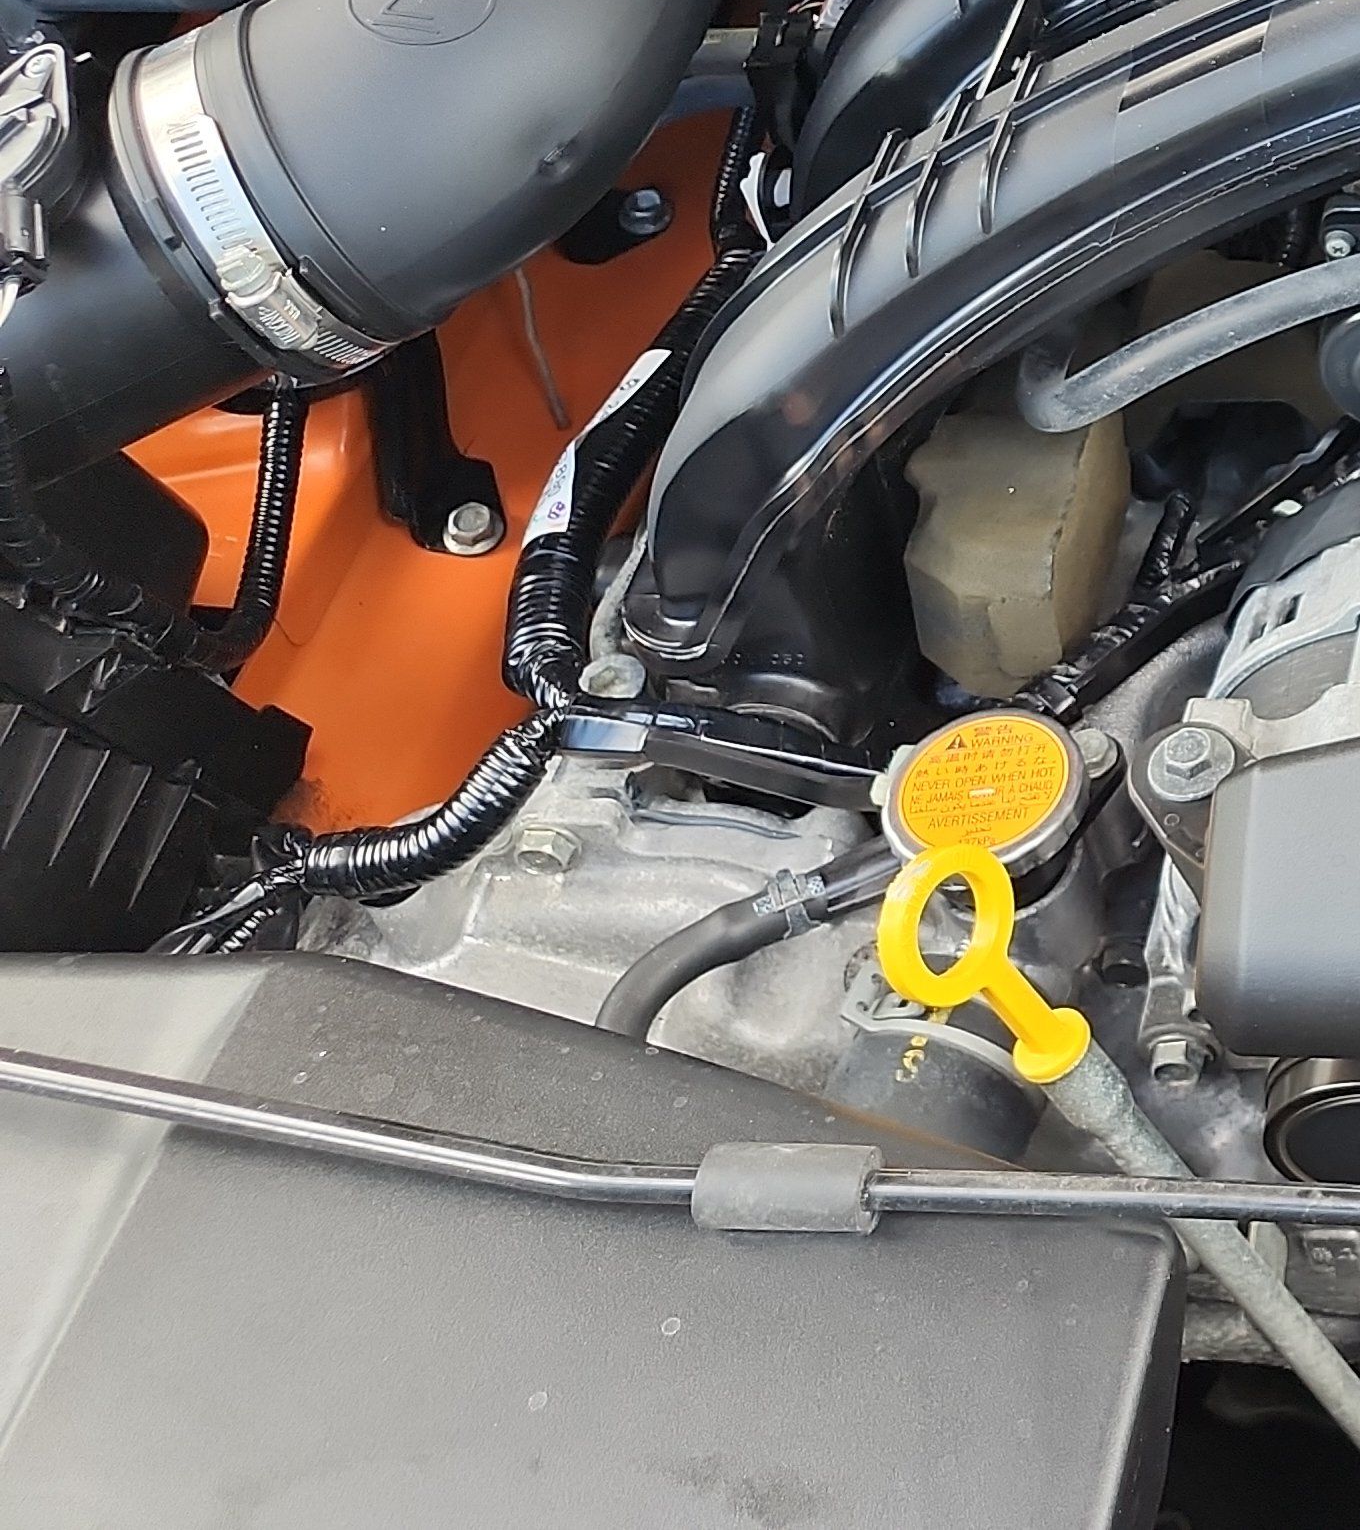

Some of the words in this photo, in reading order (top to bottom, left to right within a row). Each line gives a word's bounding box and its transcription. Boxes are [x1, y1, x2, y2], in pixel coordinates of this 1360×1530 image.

[970, 733, 1034, 748] WARNING
[913, 779, 951, 791] NEVER
[955, 775, 986, 788] OPEN
[991, 772, 1026, 785] WHEN
[926, 791, 963, 803] JAMAIS
[927, 807, 1030, 829] AVERTISSEMENT
